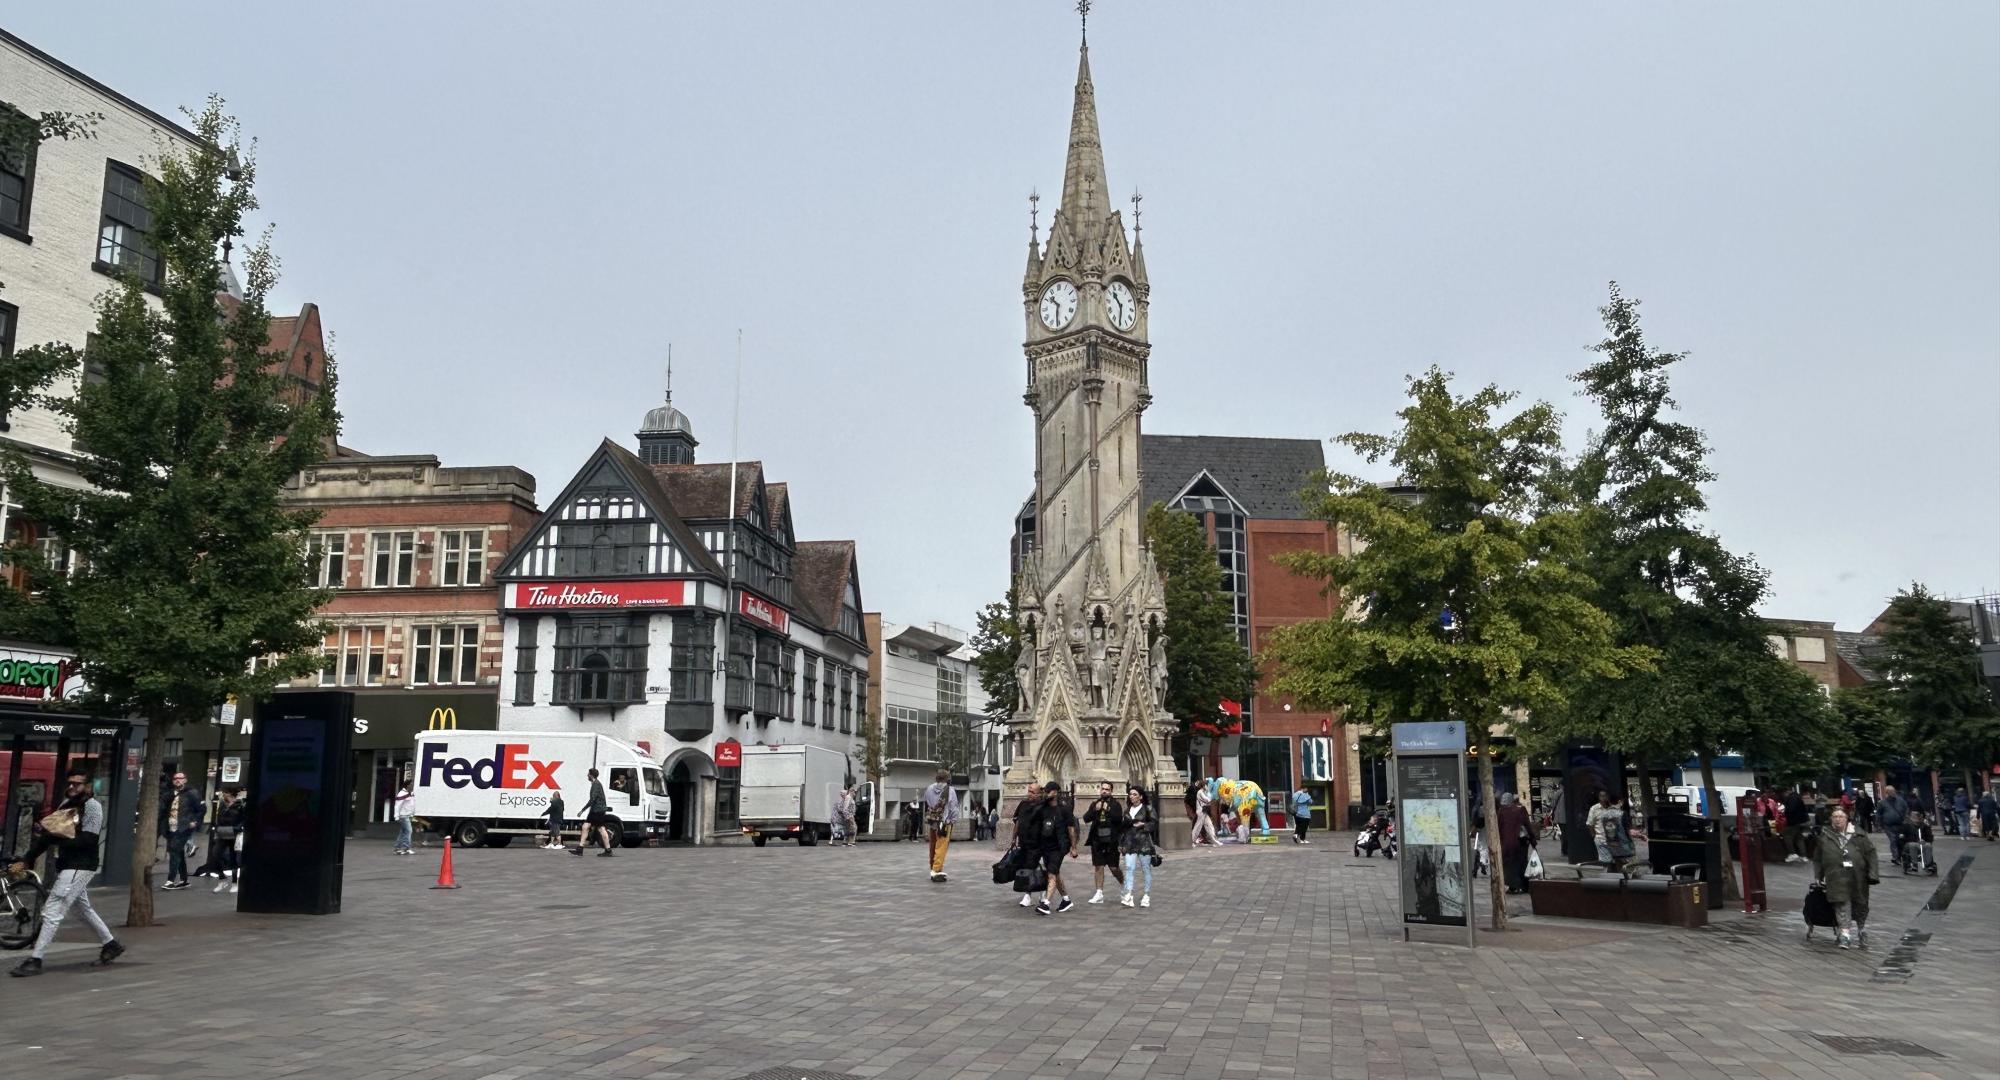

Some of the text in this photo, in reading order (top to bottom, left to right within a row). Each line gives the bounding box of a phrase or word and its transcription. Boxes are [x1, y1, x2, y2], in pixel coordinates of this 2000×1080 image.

[528, 585, 619, 605] Tim Hortons
[419, 742, 565, 790] FedEx
[499, 792, 548, 808] Express
